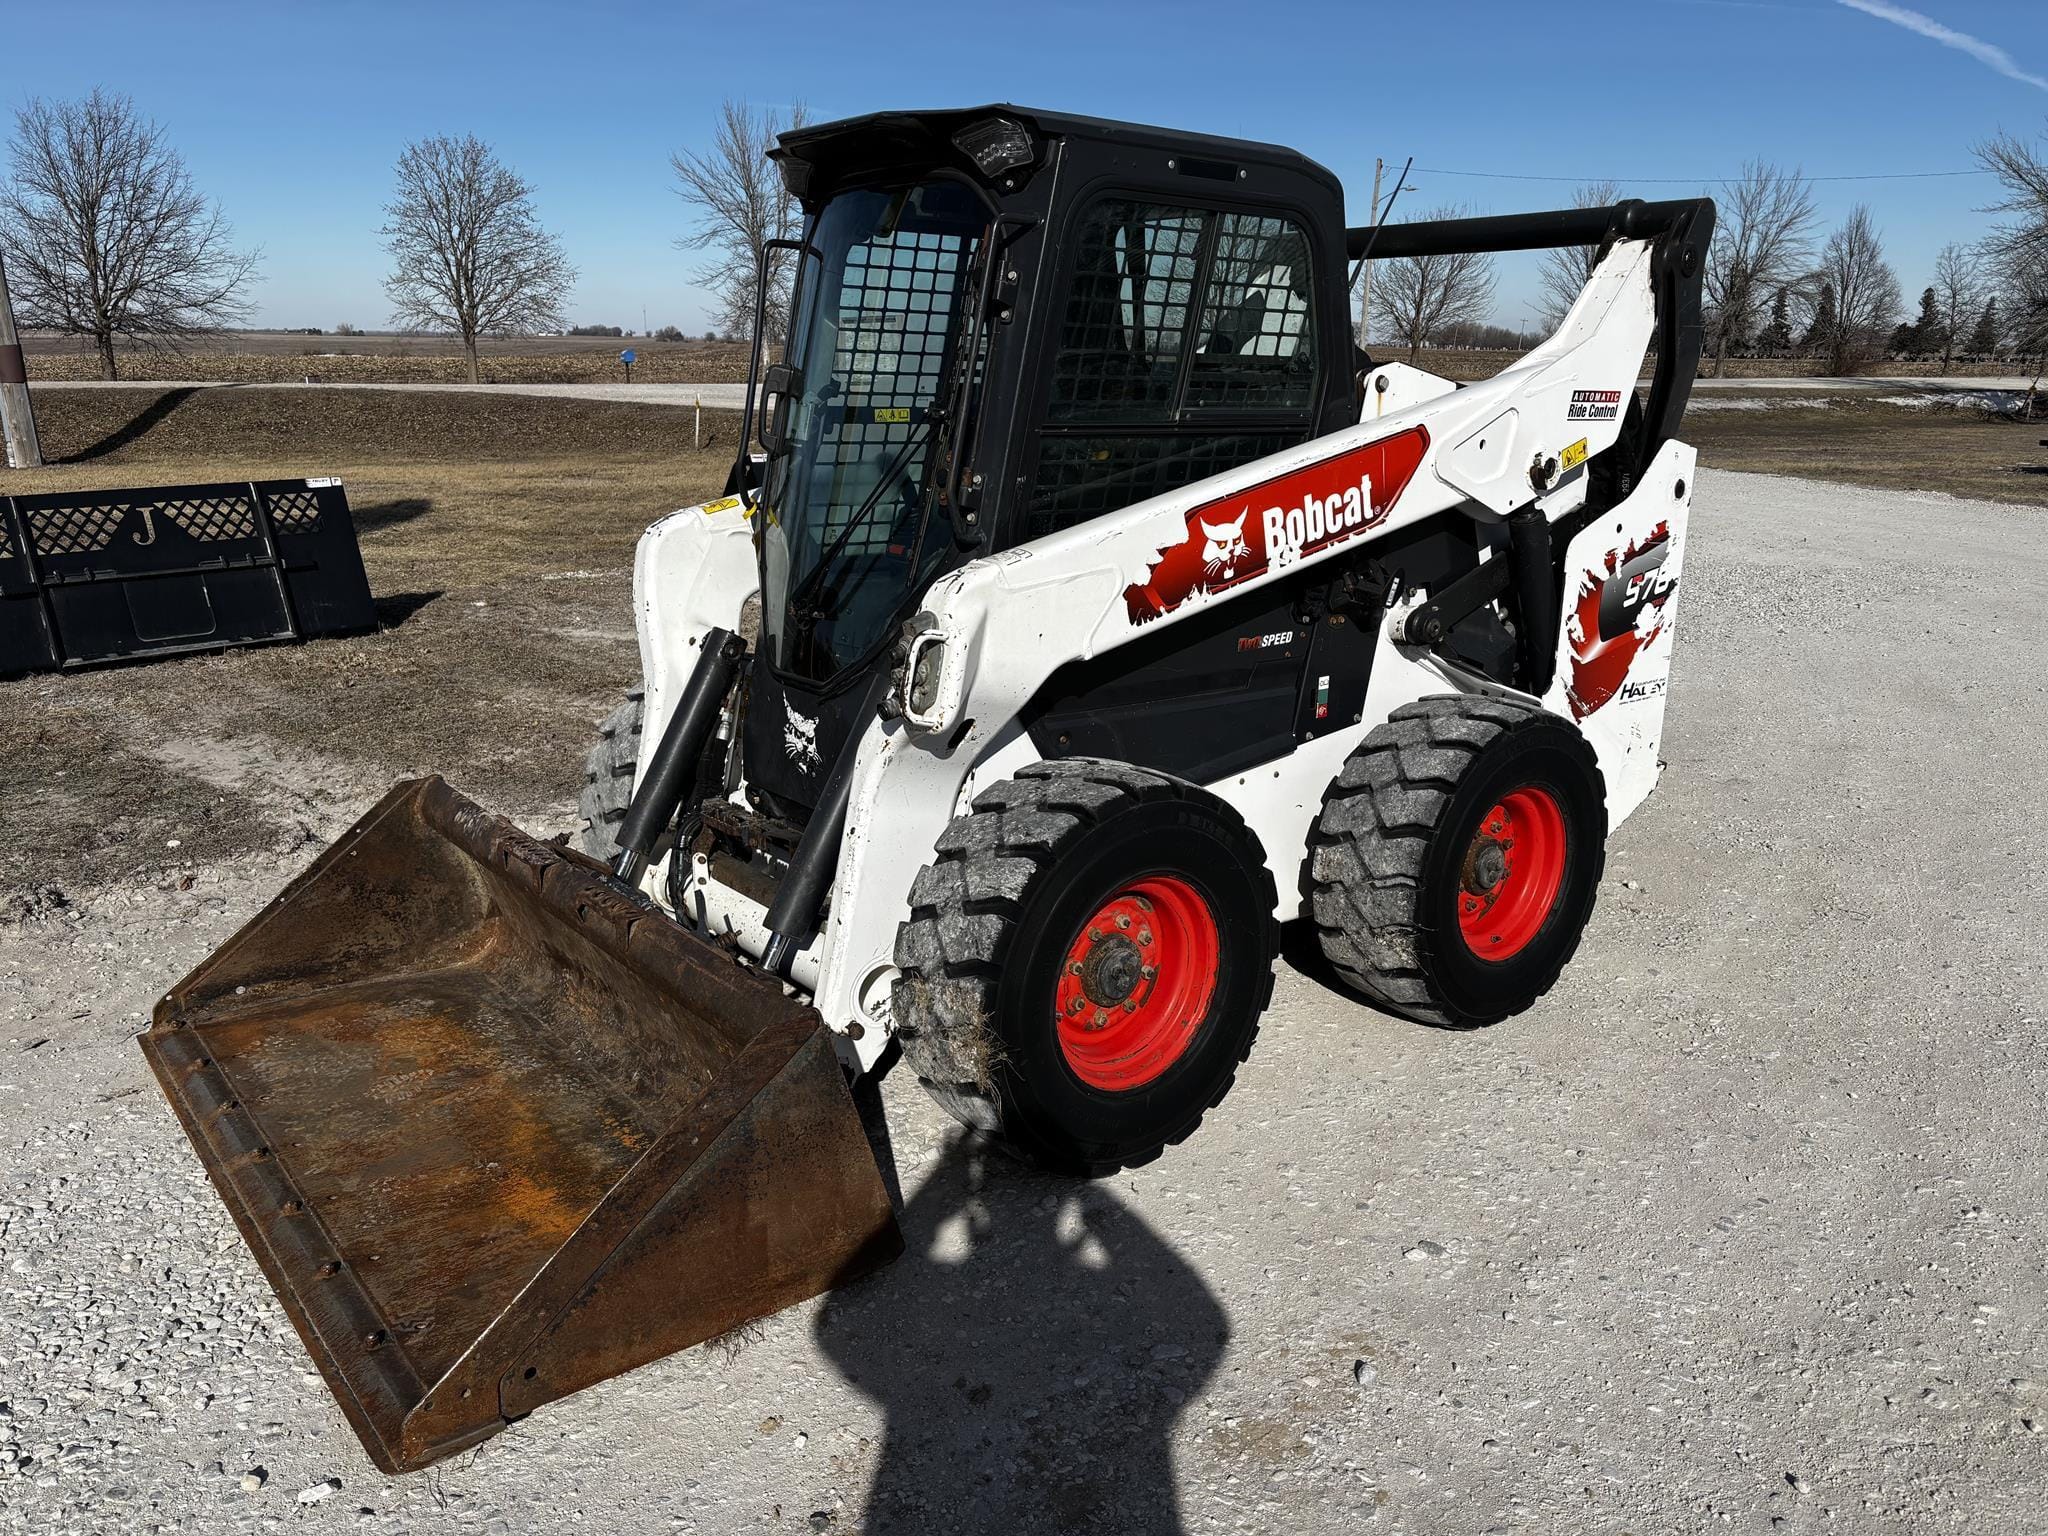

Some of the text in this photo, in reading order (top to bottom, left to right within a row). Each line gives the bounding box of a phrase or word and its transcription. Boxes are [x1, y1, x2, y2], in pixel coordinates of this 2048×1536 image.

[1573, 391, 1620, 402] AUTOMATIC
[1567, 403, 1619, 418] Ride Control
[1262, 473, 1374, 560] Bobcat
